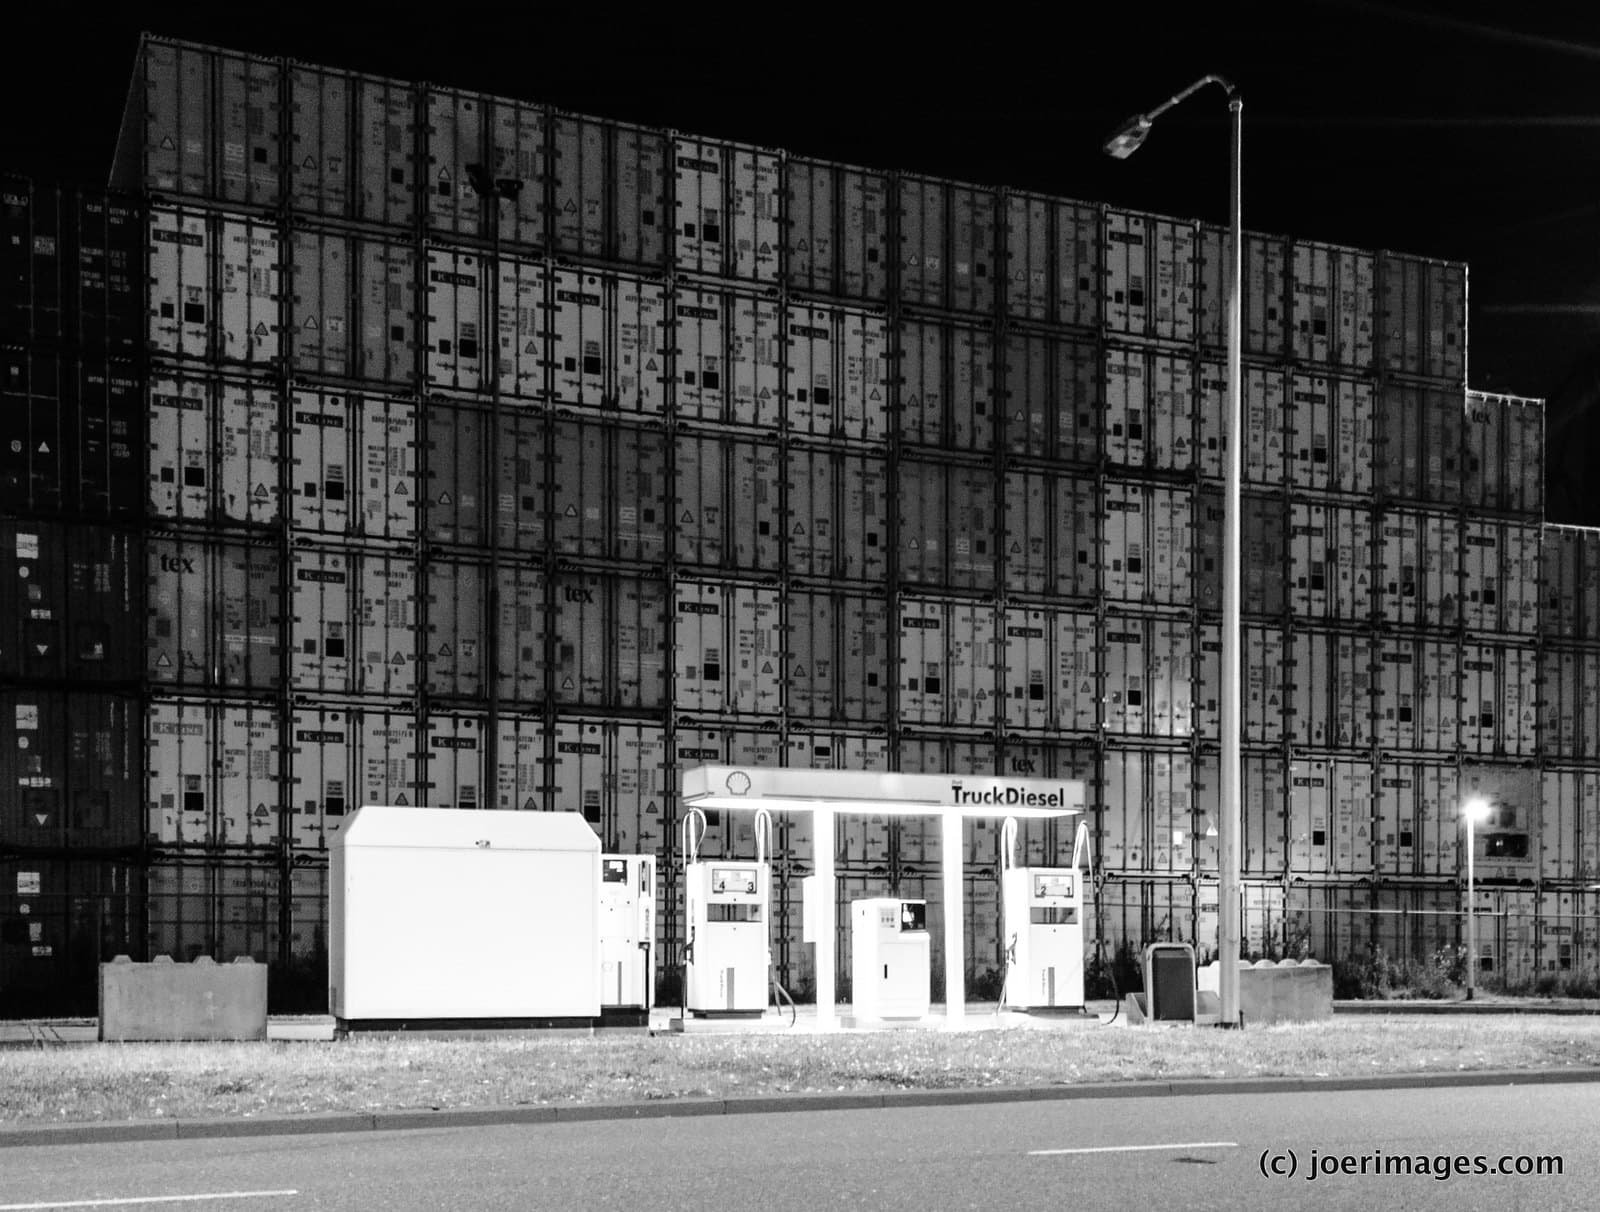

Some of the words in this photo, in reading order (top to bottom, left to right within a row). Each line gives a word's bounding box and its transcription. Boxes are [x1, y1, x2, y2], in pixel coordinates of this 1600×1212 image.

[1206, 505, 1225, 521] te
[160, 553, 194, 574] tex
[565, 584, 593, 604] tex
[1012, 755, 1035, 773] tex
[952, 785, 1063, 807] TruckDiesel
[719, 881, 725, 891] 4
[747, 881, 754, 892] 3
[1040, 885, 1046, 896] 2
